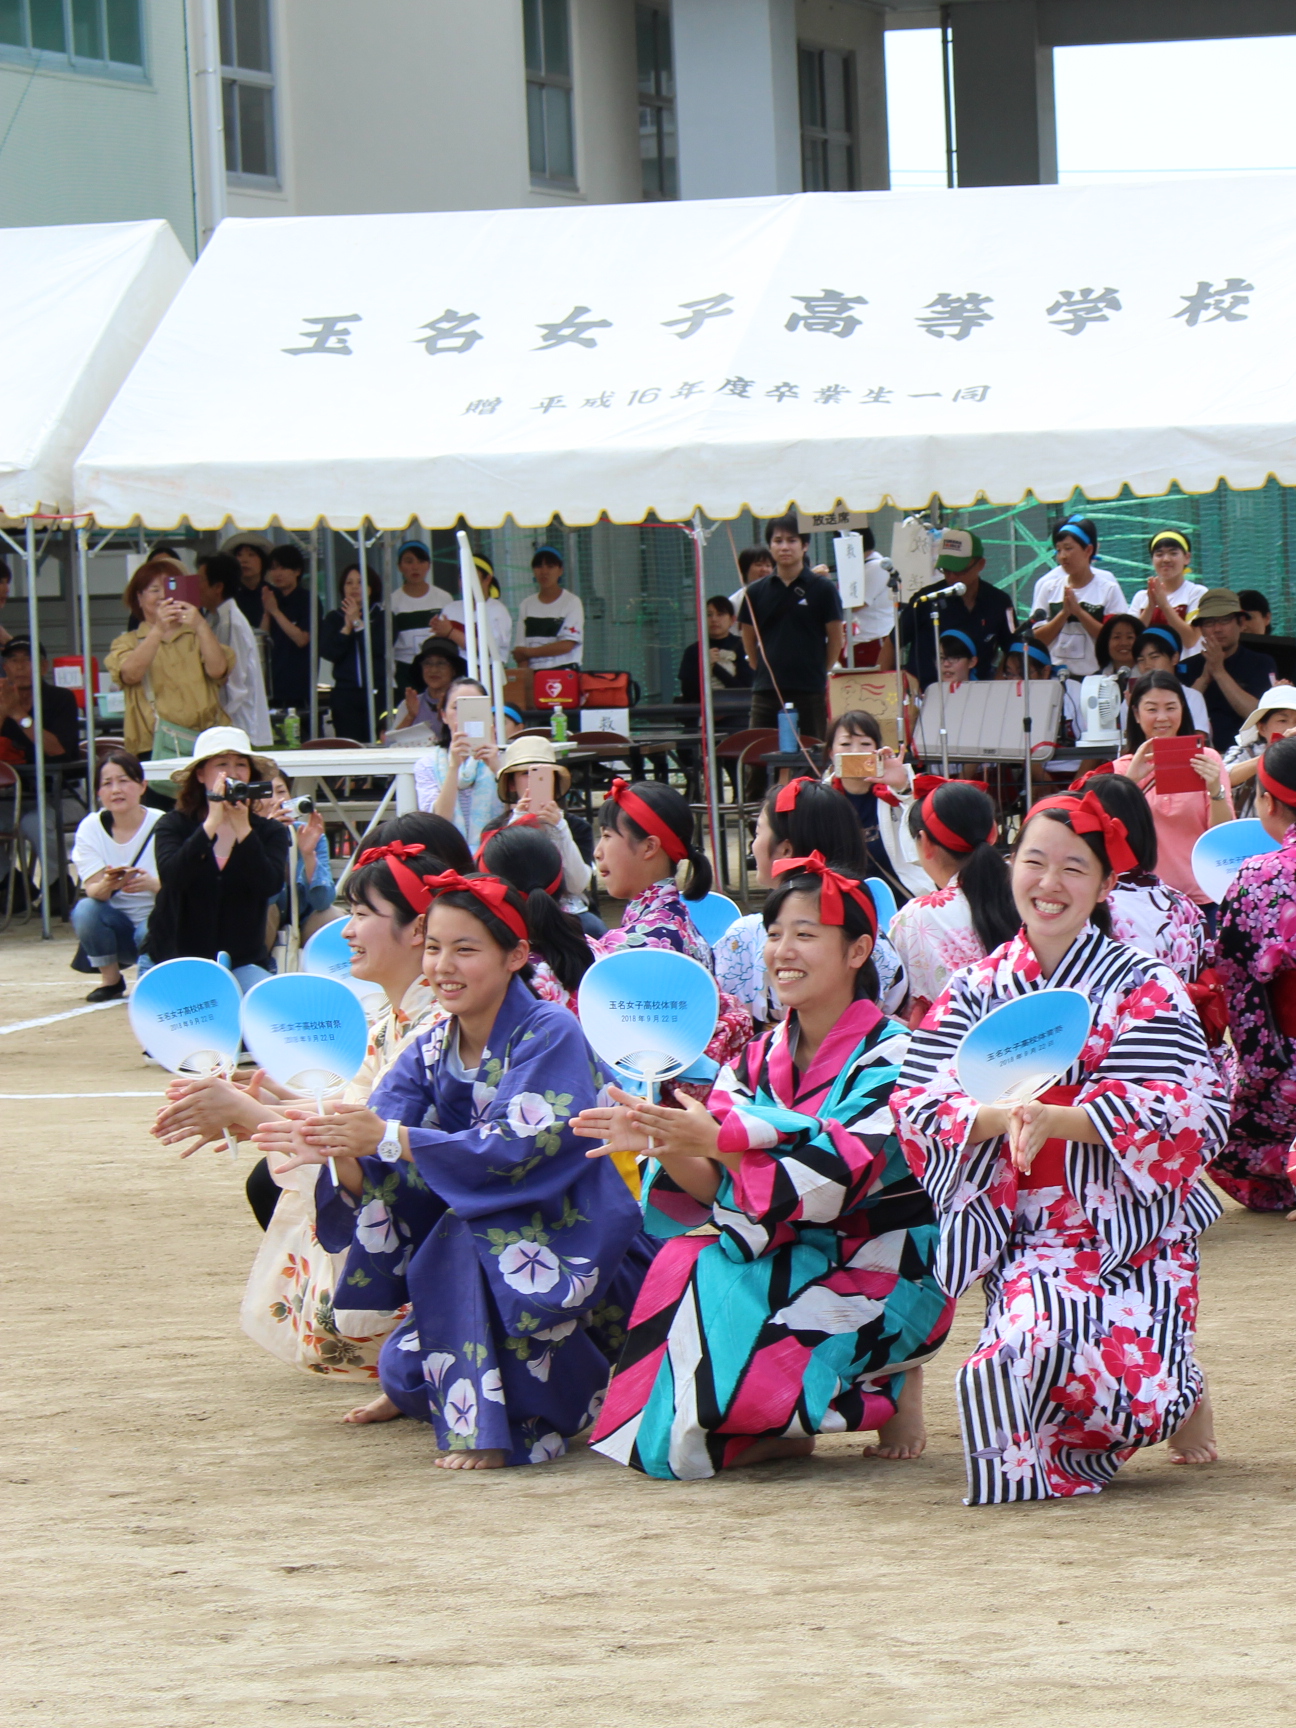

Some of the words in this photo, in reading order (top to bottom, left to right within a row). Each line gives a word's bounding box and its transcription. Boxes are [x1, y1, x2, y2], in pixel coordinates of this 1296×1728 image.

[281, 278, 1254, 356] 玉名女子高等学校
[812, 512, 850, 526] 放送席
[608, 1000, 687, 1010] 玉名女子高校体育祭
[621, 1015, 678, 1023] 2018年9月22日
